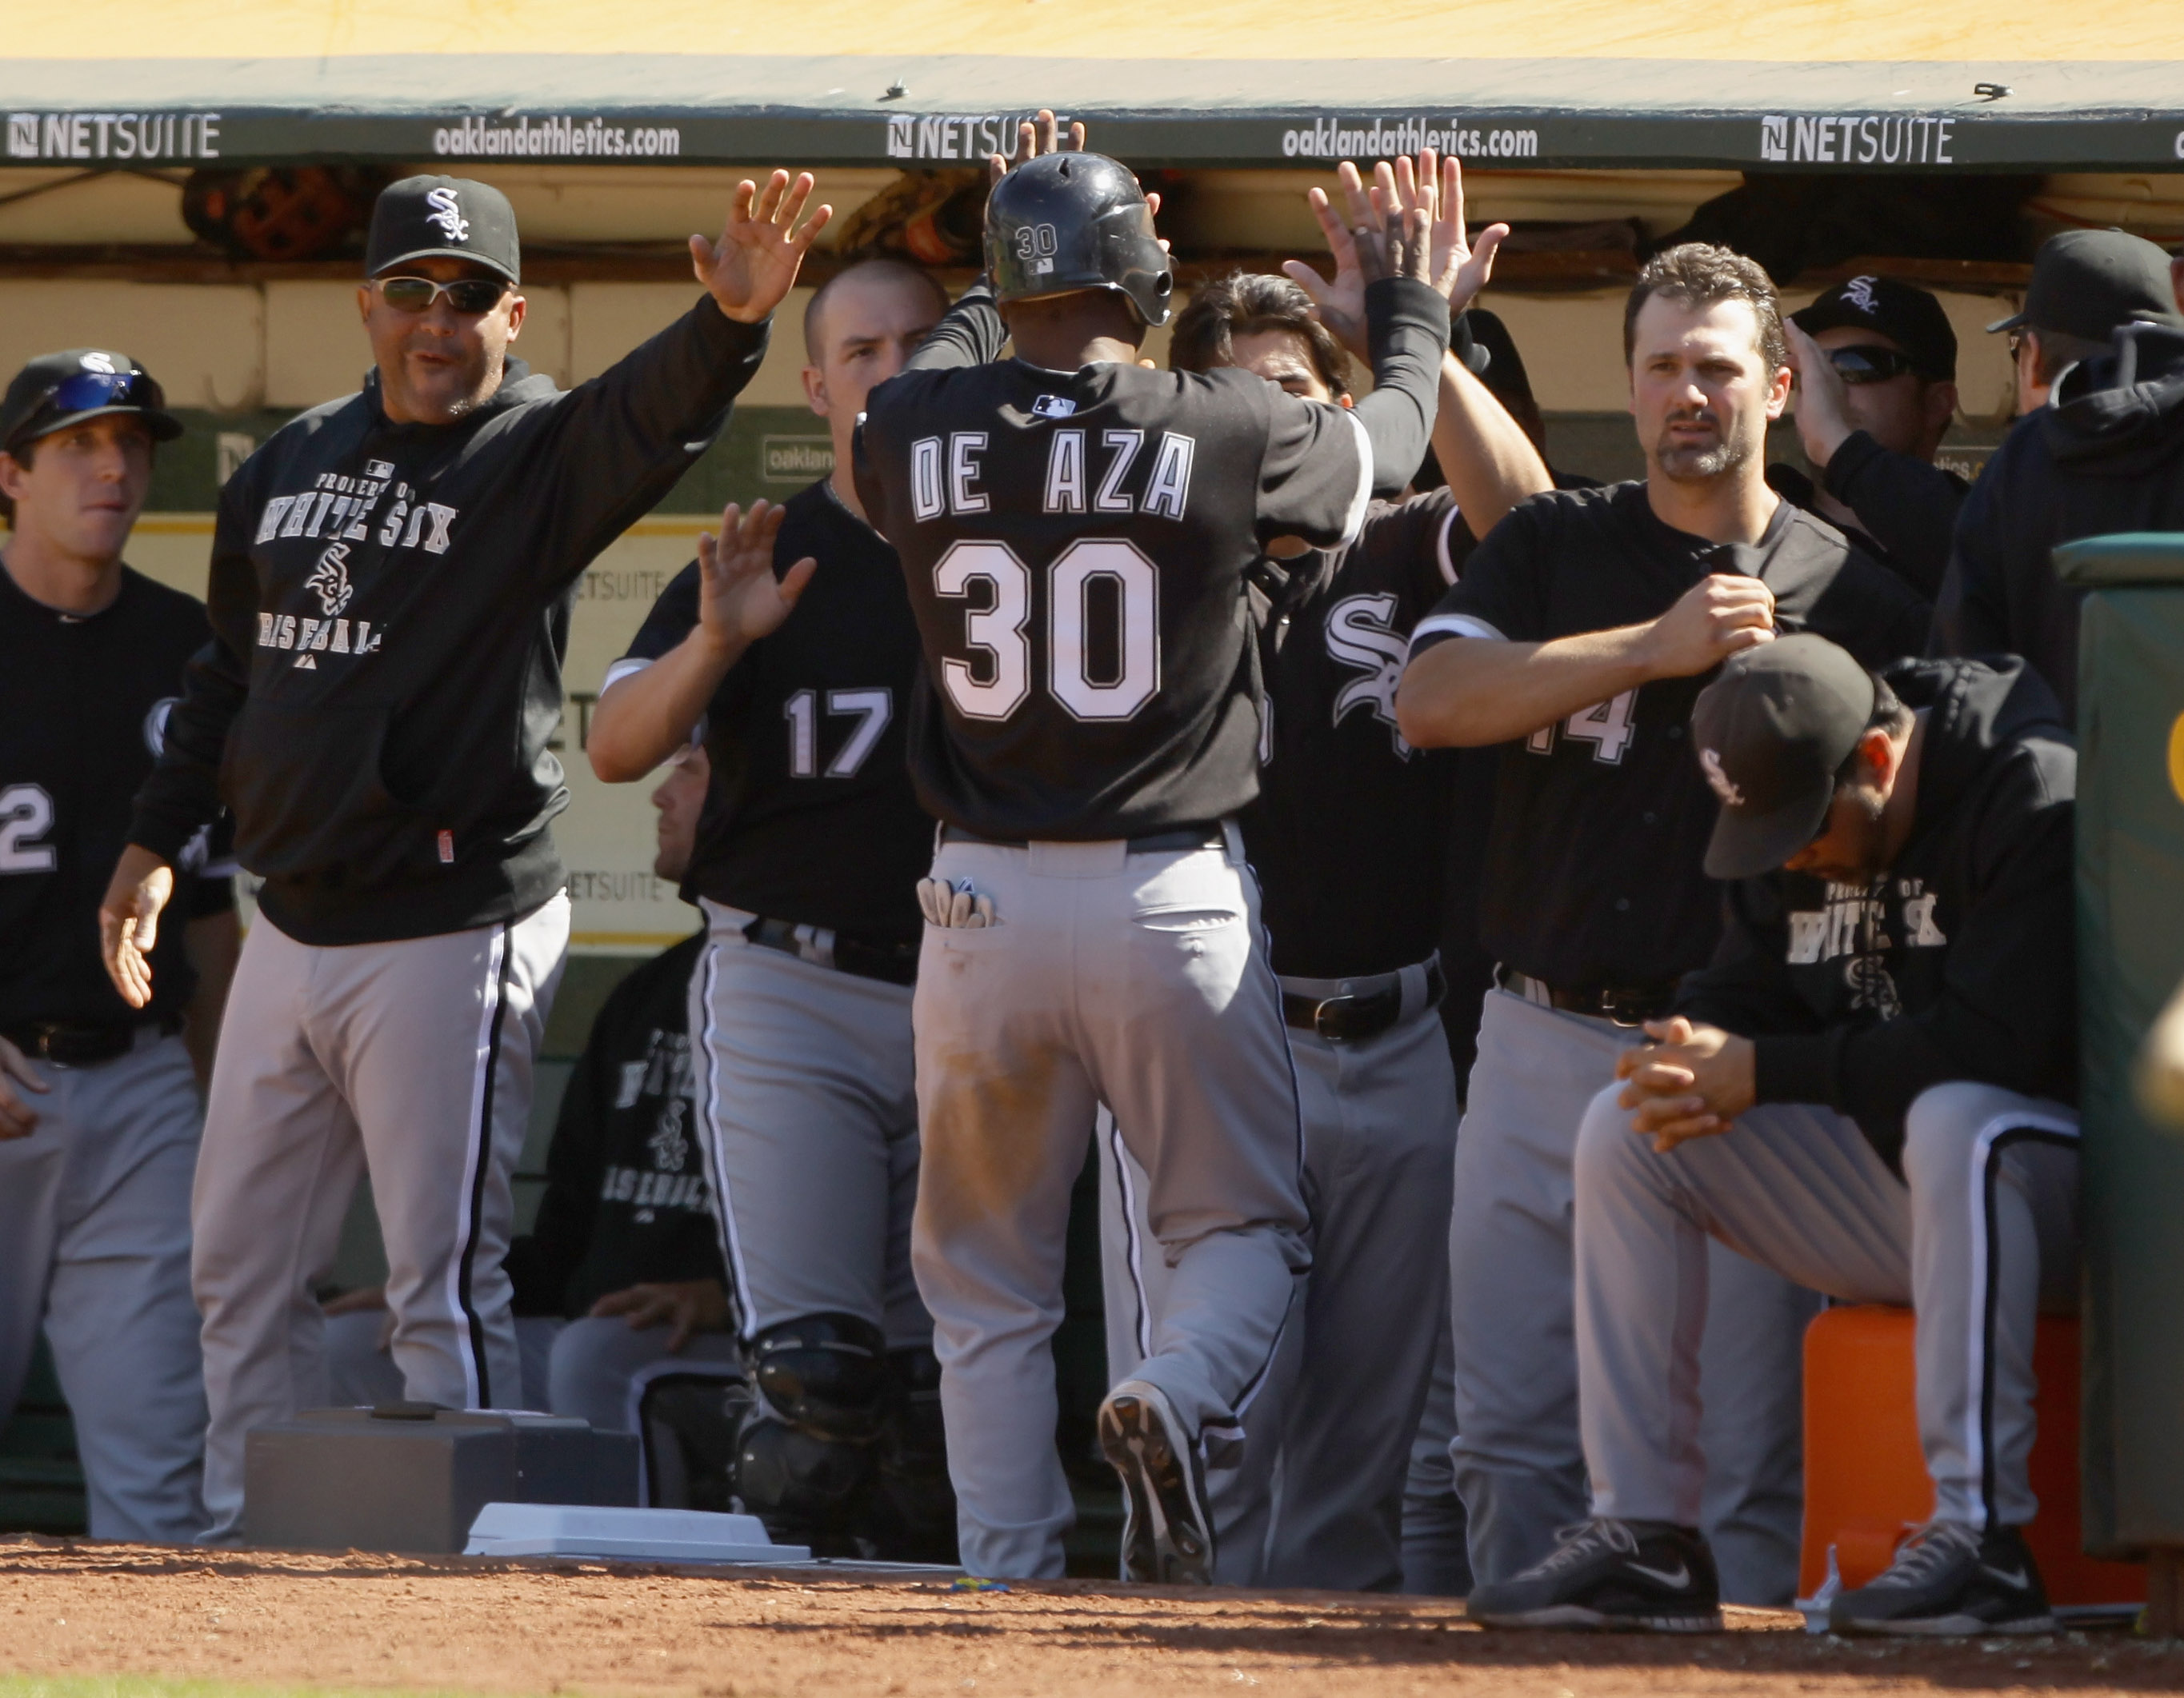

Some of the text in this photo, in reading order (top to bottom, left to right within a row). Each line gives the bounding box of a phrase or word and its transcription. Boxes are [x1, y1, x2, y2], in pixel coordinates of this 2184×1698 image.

[42, 114, 221, 158] NETSUITE
[434, 117, 680, 155] oaklandathletics.com
[1282, 118, 1538, 157] oaklandathletics.com
[1793, 115, 1956, 164] NETSUITE
[1015, 223, 1058, 260] 30
[910, 429, 1196, 523] DE AZA
[933, 537, 1162, 722] 30
[784, 686, 894, 779] 17
